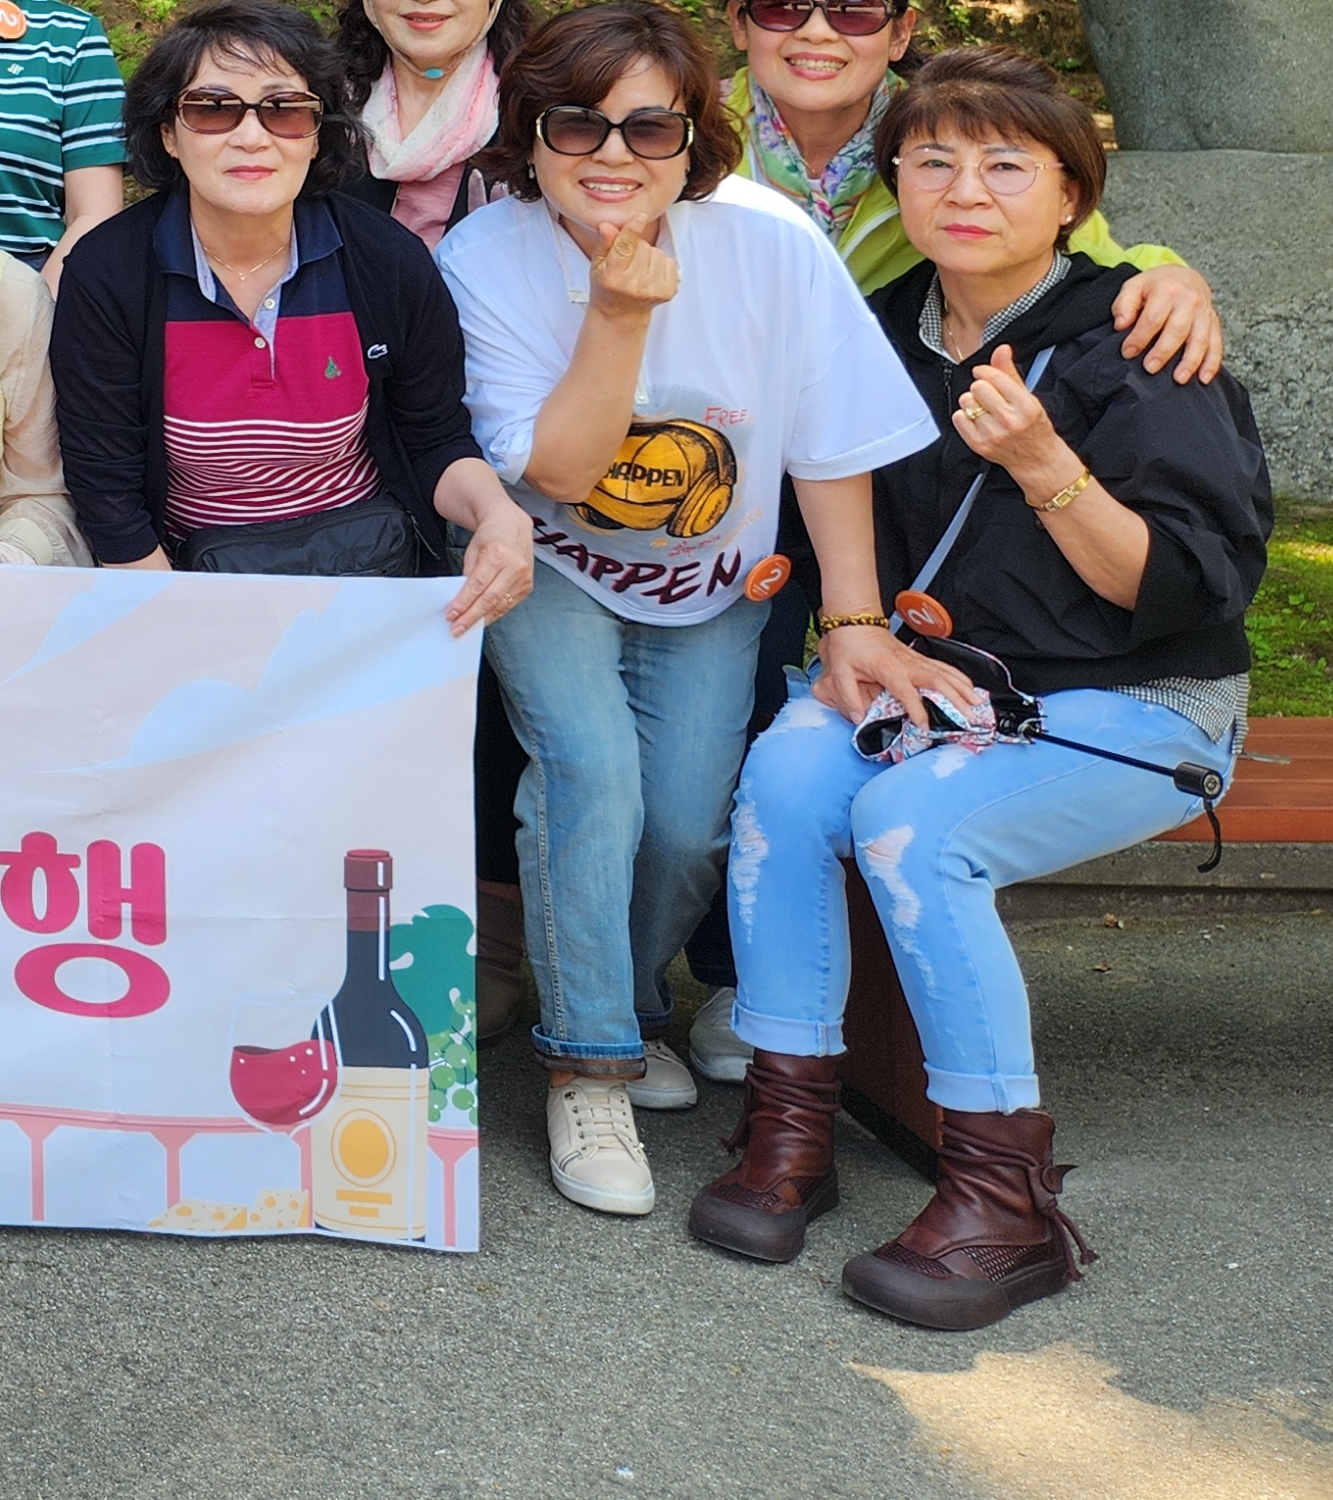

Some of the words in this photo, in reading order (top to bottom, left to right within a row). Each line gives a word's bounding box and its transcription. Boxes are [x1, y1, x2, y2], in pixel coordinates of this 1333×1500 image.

[704, 406, 748, 429] FREE
[760, 567, 782, 591] 2
[907, 608, 935, 625] 2
